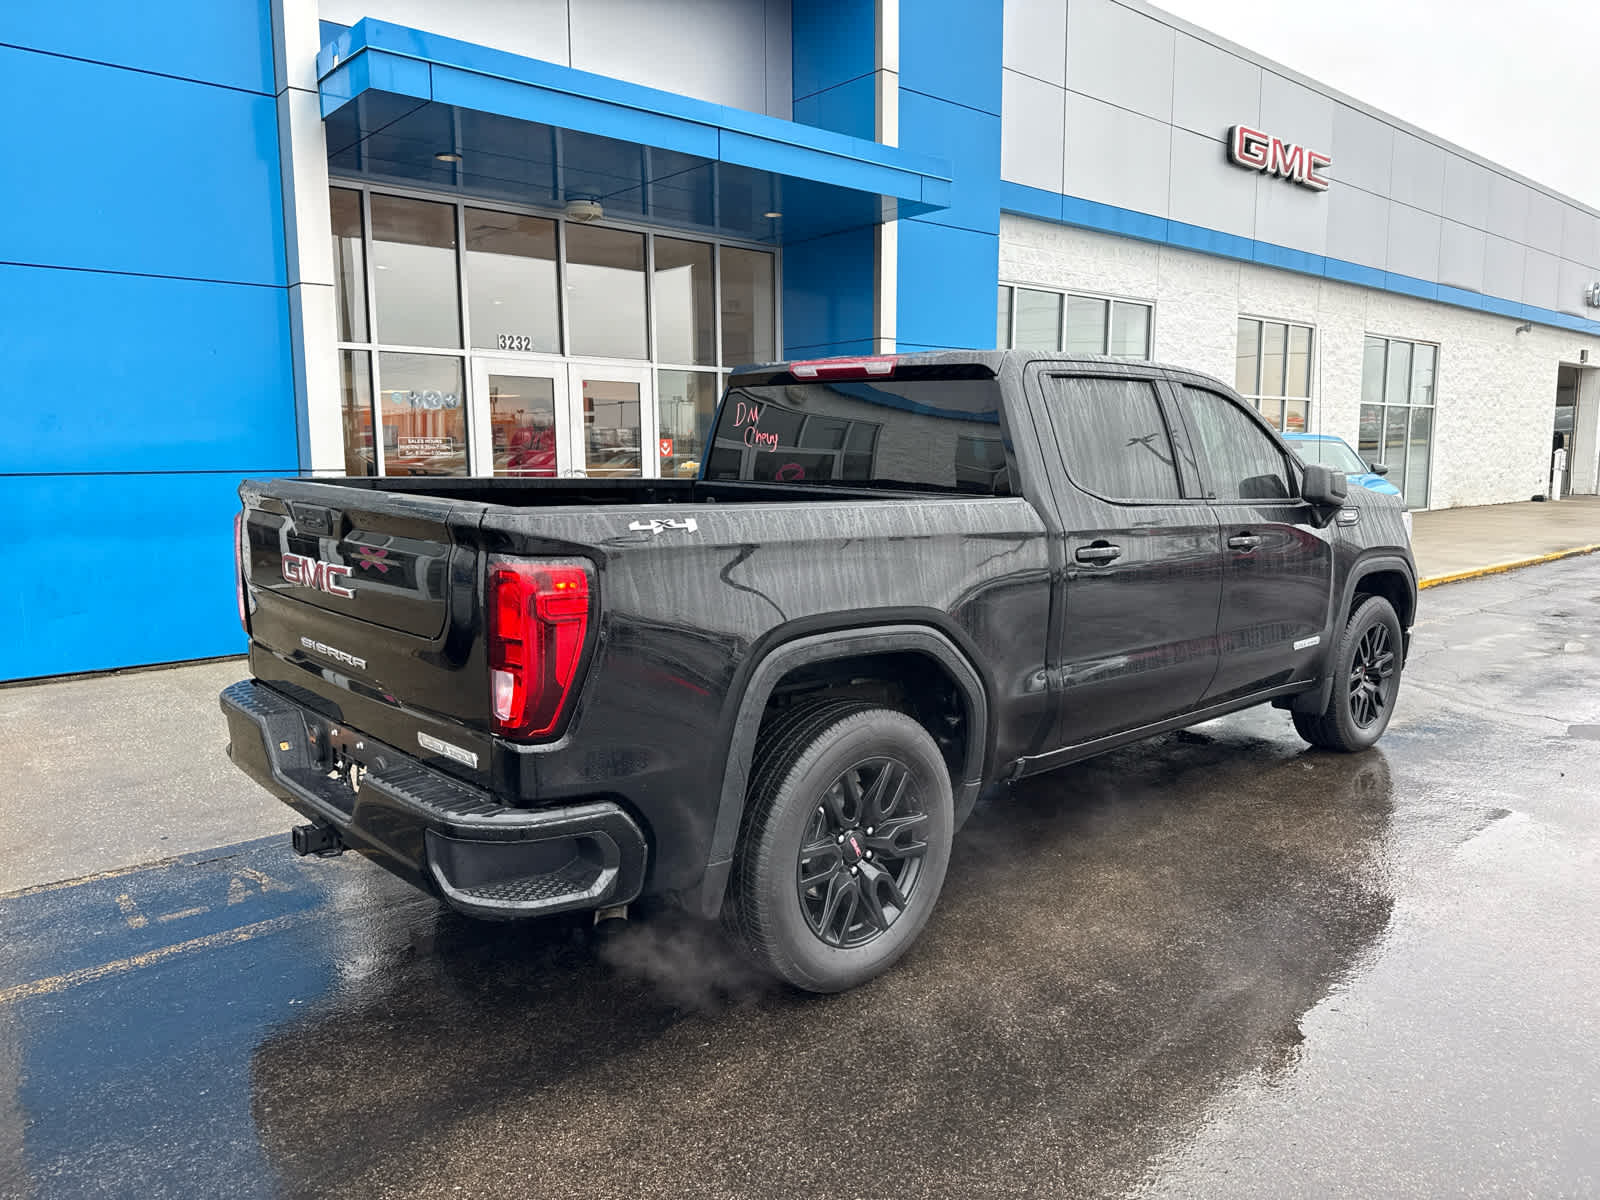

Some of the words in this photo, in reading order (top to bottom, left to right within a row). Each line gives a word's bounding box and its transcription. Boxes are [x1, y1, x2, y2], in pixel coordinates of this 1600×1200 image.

[1230, 124, 1331, 191] GMC
[499, 334, 531, 351] 3232
[744, 426, 778, 453] Chevy
[281, 552, 357, 600] GMC
[301, 636, 368, 670] SIERRA
